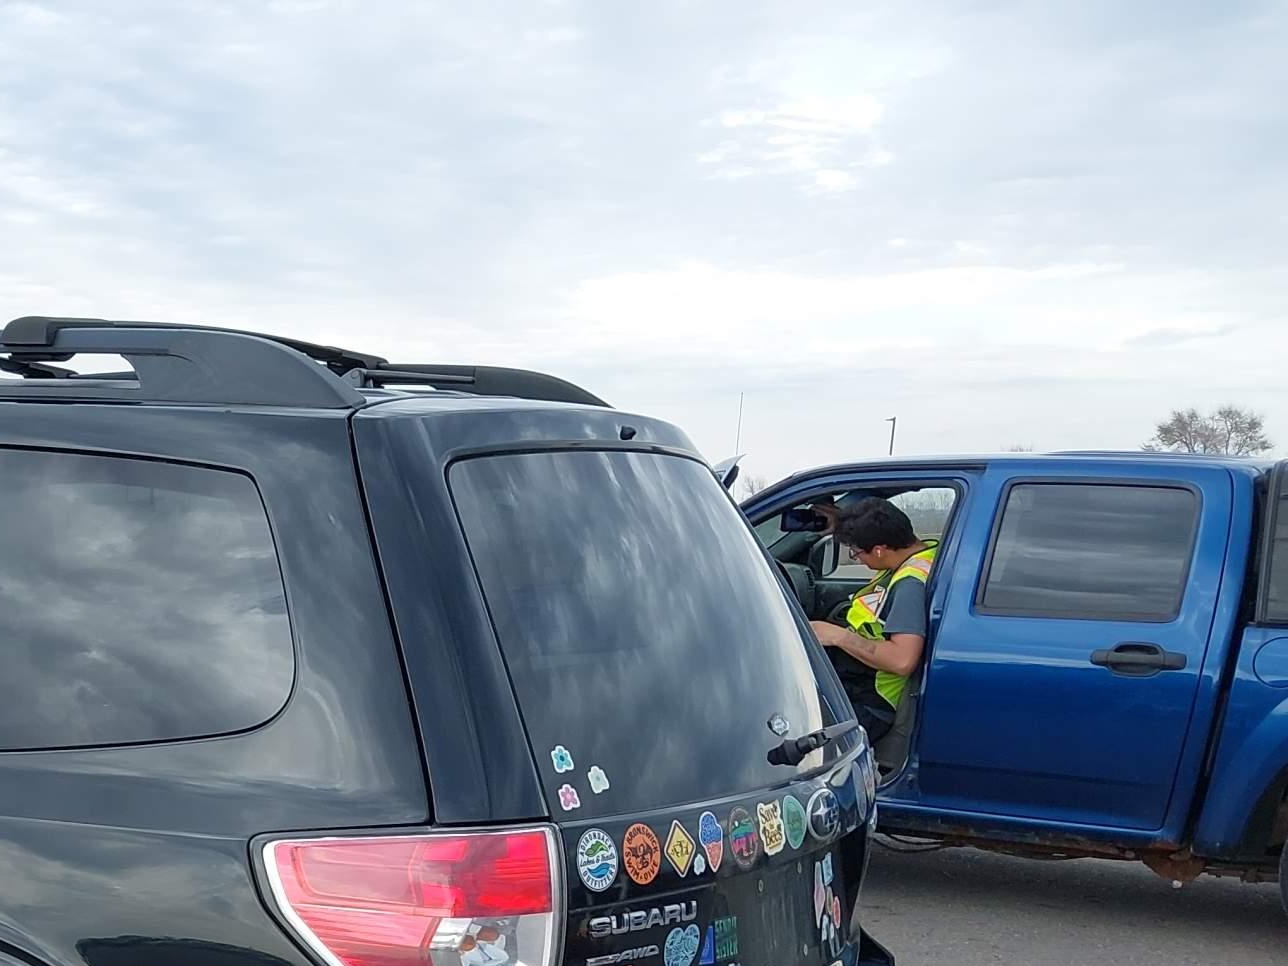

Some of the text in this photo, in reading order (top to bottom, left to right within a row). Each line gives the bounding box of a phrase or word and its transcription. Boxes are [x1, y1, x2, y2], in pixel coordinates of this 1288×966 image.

[759, 804, 778, 824] Save
[579, 831, 613, 857] ADIRONDACK
[763, 829, 783, 847] Bees
[589, 900, 697, 939] SUBARU
[616, 944, 660, 962] AWD
